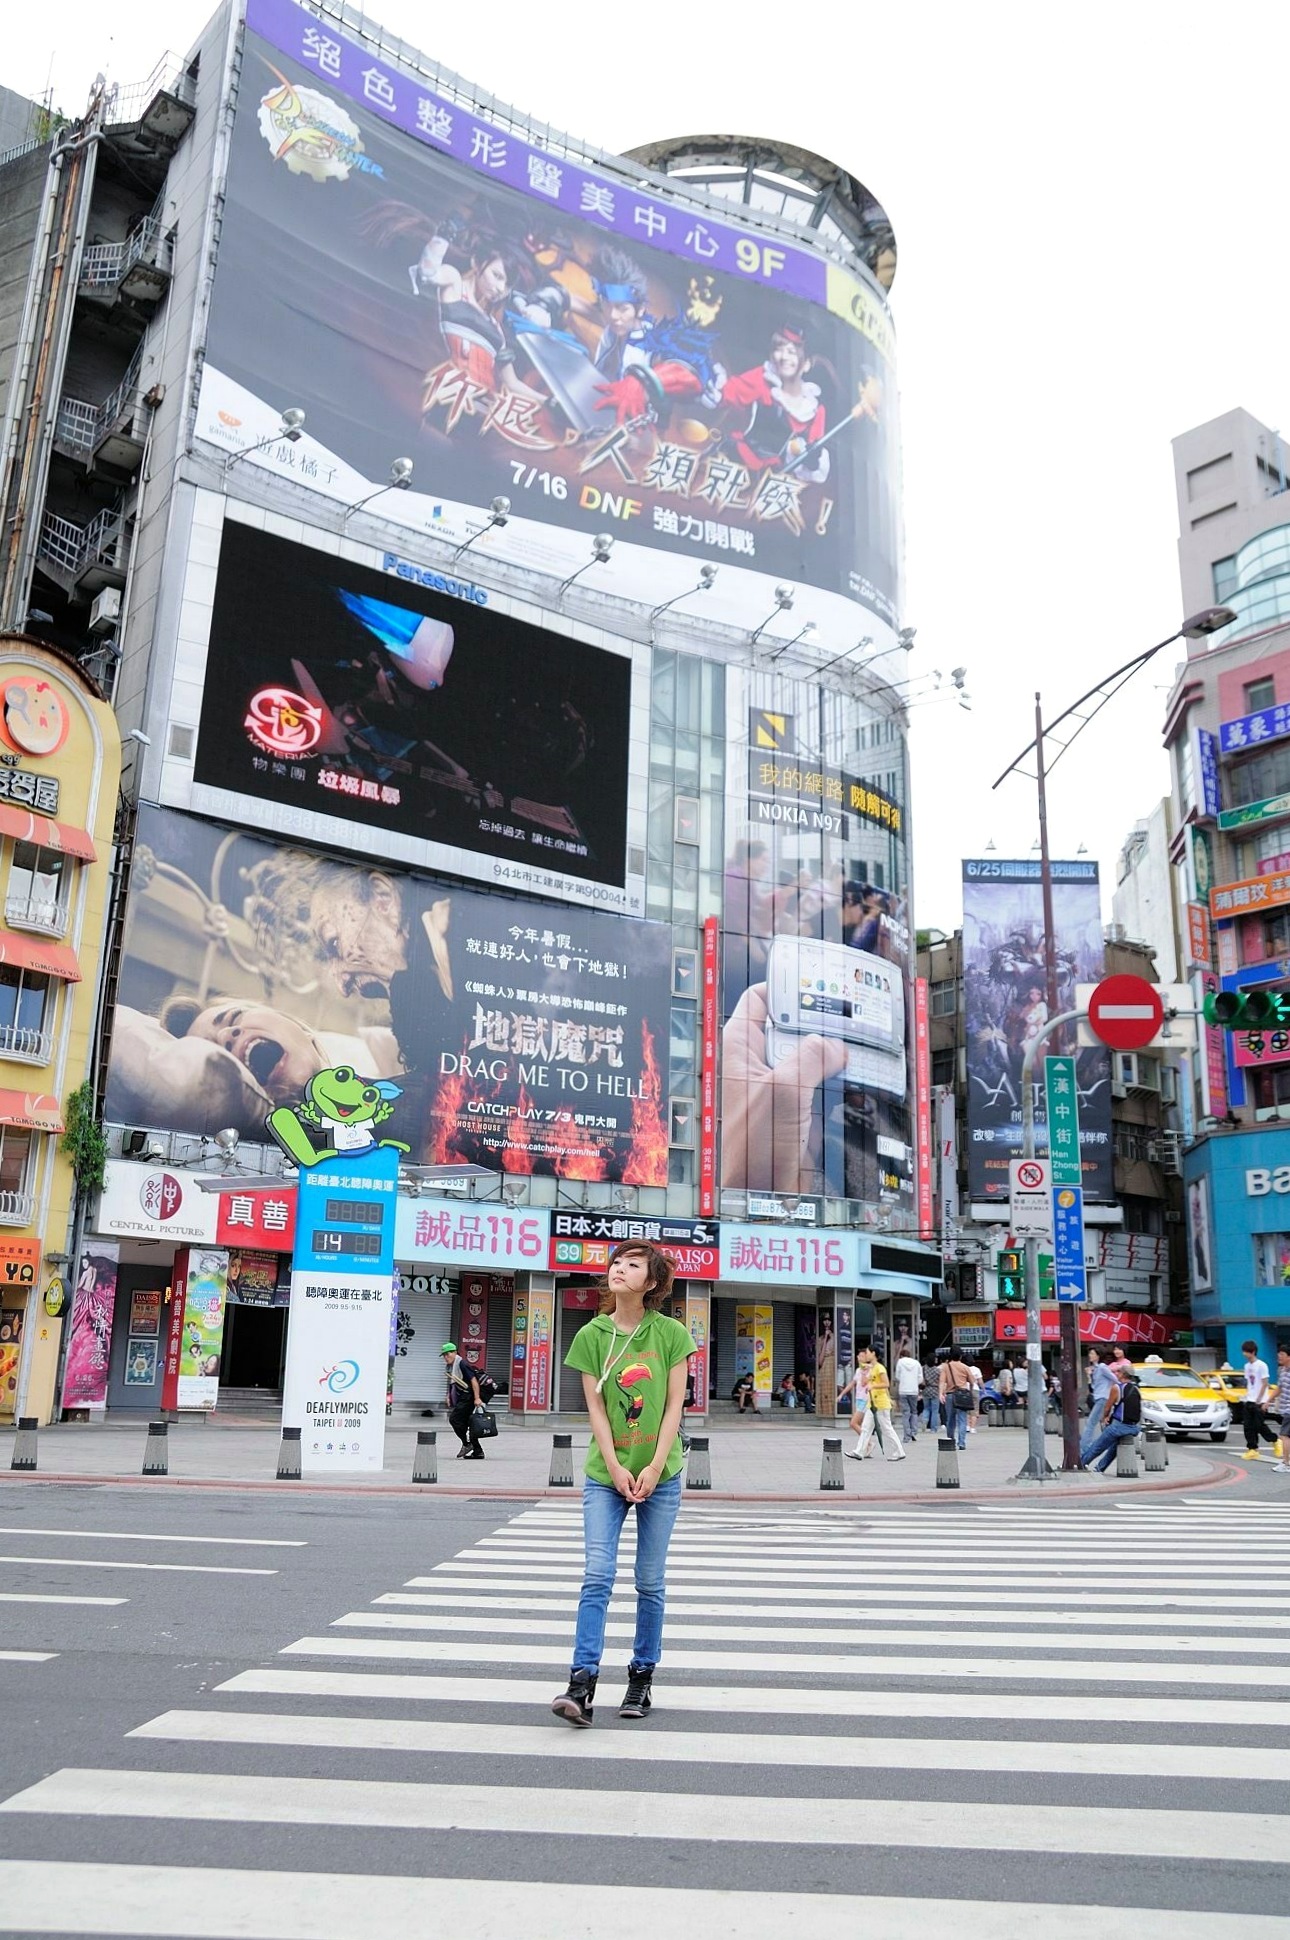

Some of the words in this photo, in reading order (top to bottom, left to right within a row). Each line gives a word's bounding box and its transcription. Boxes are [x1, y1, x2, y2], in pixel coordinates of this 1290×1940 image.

[302, 27, 719, 260] 絕色整形醫美中心
[735, 238, 786, 278] 9F
[208, 423, 246, 448] gamania
[509, 459, 568, 501] 7/16
[578, 484, 642, 522] DNF
[652, 505, 756, 557] 強力開戰
[382, 551, 488, 605] Panasonic
[246, 733, 319, 761] MATERIAL
[317, 768, 401, 806] 垃圾風暴
[759, 762, 844, 802] 我的網路
[759, 801, 809, 826] NOKIA
[813, 811, 842, 834] N97
[467, 1001, 625, 1069] 地獄魔咒
[440, 1052, 508, 1081] DRAG
[518, 1063, 550, 1088] ME
[556, 1068, 589, 1092] TO
[596, 1073, 649, 1100] HELL
[467, 1101, 544, 1121] CATCHPLAY
[545, 1110, 572, 1123] 7/3
[574, 1113, 617, 1129] 鬼門大開
[1053, 1077, 1072, 1145] 漢中街
[477, 1122, 501, 1132] HOUSE
[483, 1137, 600, 1157] http://www.catchplay.com/hell
[1052, 1149, 1069, 1159] Han
[1052, 1161, 1079, 1171] Zhong
[306, 1173, 394, 1192] 距離臺北聽障奧運
[109, 1220, 156, 1232] CENTRAL
[159, 1225, 205, 1237] PICTURES
[415, 1210, 542, 1257] 誠品116
[692, 1225, 715, 1244] 5F
[323, 1233, 342, 1251] 14
[676, 1264, 701, 1273] APAN
[730, 1236, 845, 1276] 誠品116
[306, 1286, 382, 1301] 聽障奧運在臺北
[399, 1274, 450, 1294] oots
[306, 1401, 369, 1415] DEAFLYMPICS
[313, 1418, 336, 1427] TAIPEI
[344, 1418, 361, 1428] 2009
